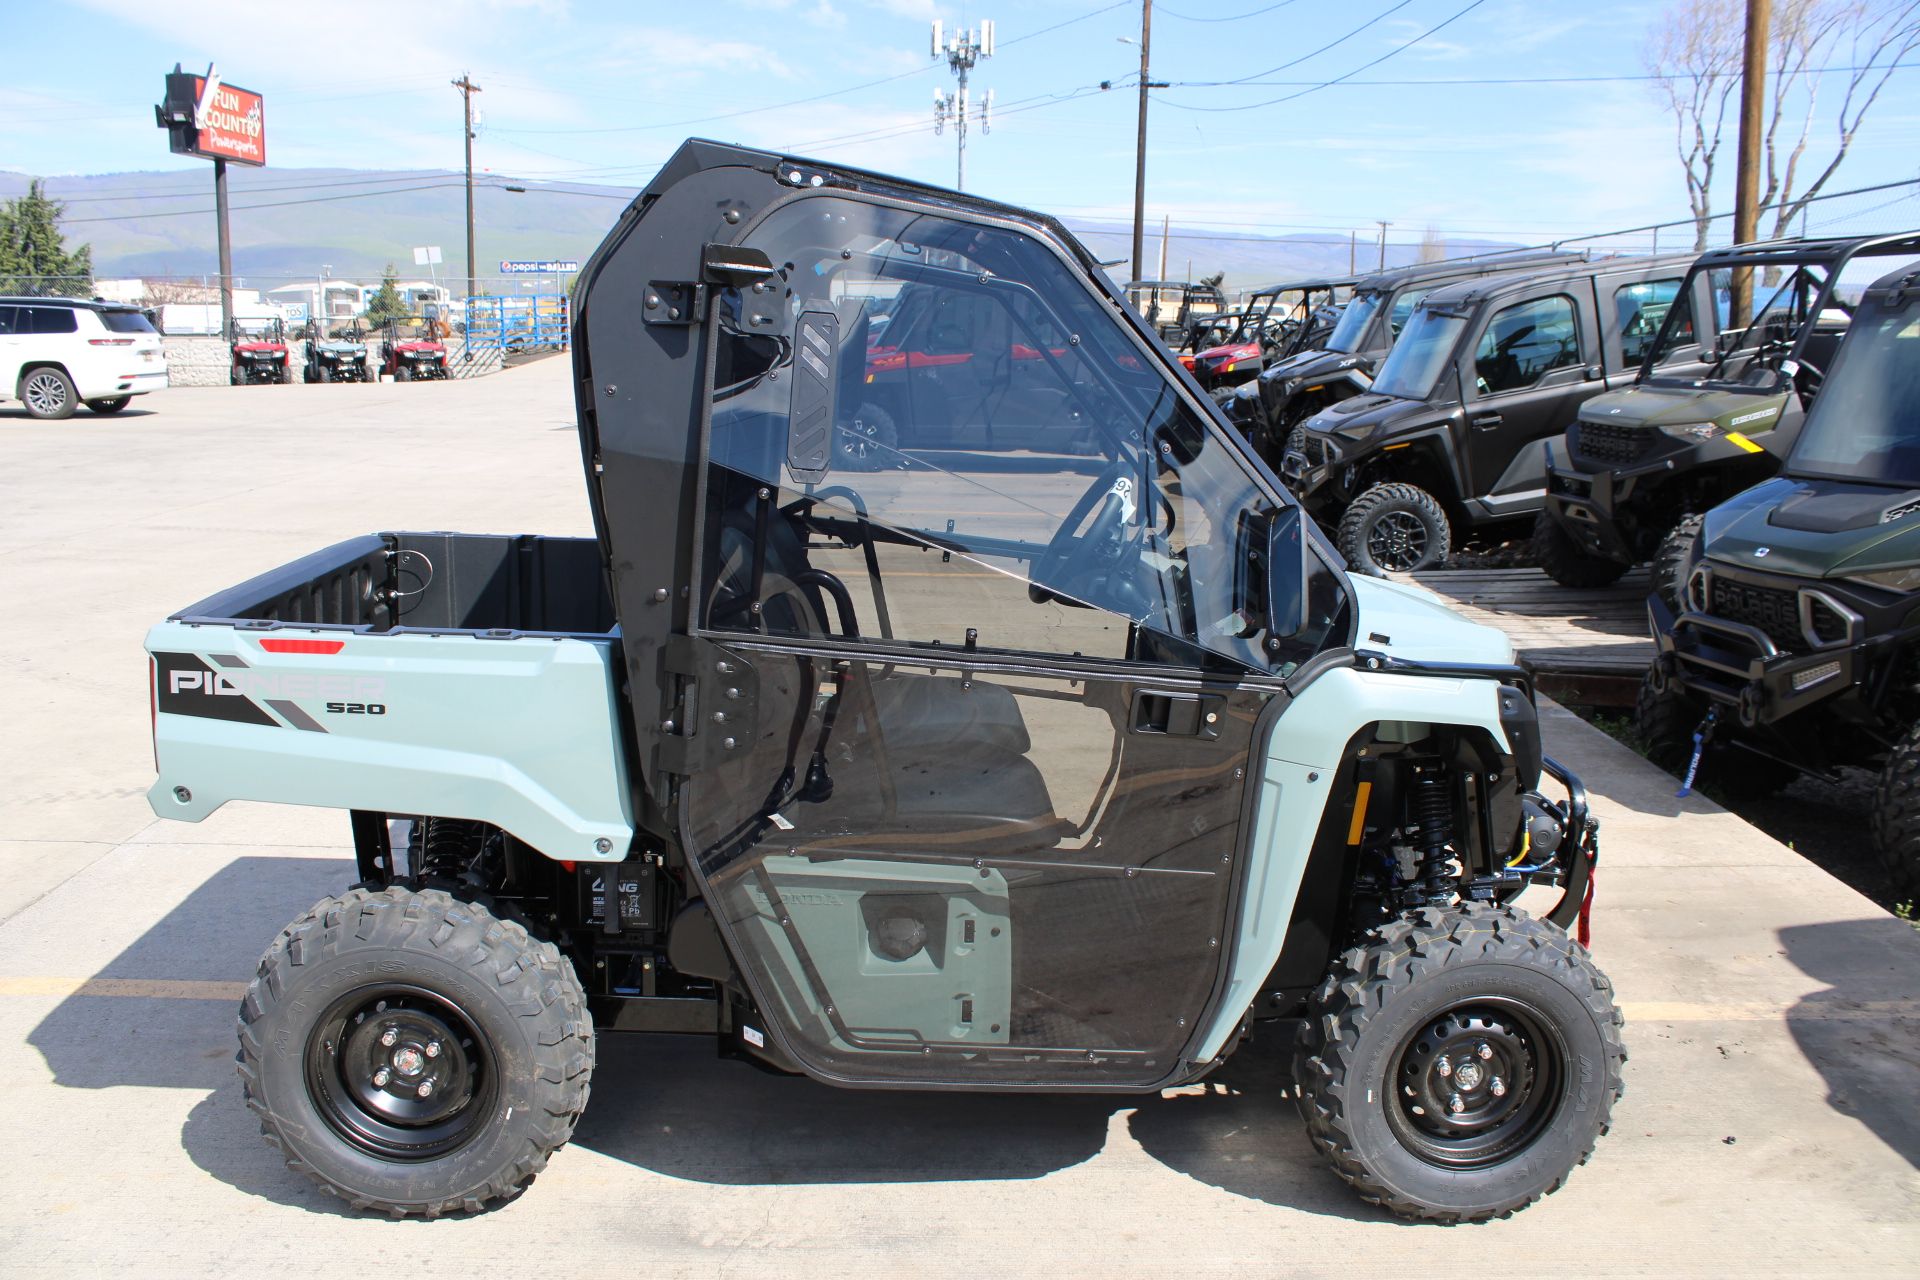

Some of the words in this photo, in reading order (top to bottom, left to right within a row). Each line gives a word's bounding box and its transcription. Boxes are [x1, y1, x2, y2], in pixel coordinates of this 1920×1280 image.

[214, 89, 239, 112] FUN
[205, 108, 261, 139] COUNTRY
[512, 262, 538, 272] pepsi
[1339, 358, 1357, 368] XP
[1715, 590, 1796, 621] POLARIS
[170, 669, 386, 700] PIONEER
[326, 702, 386, 715] 520
